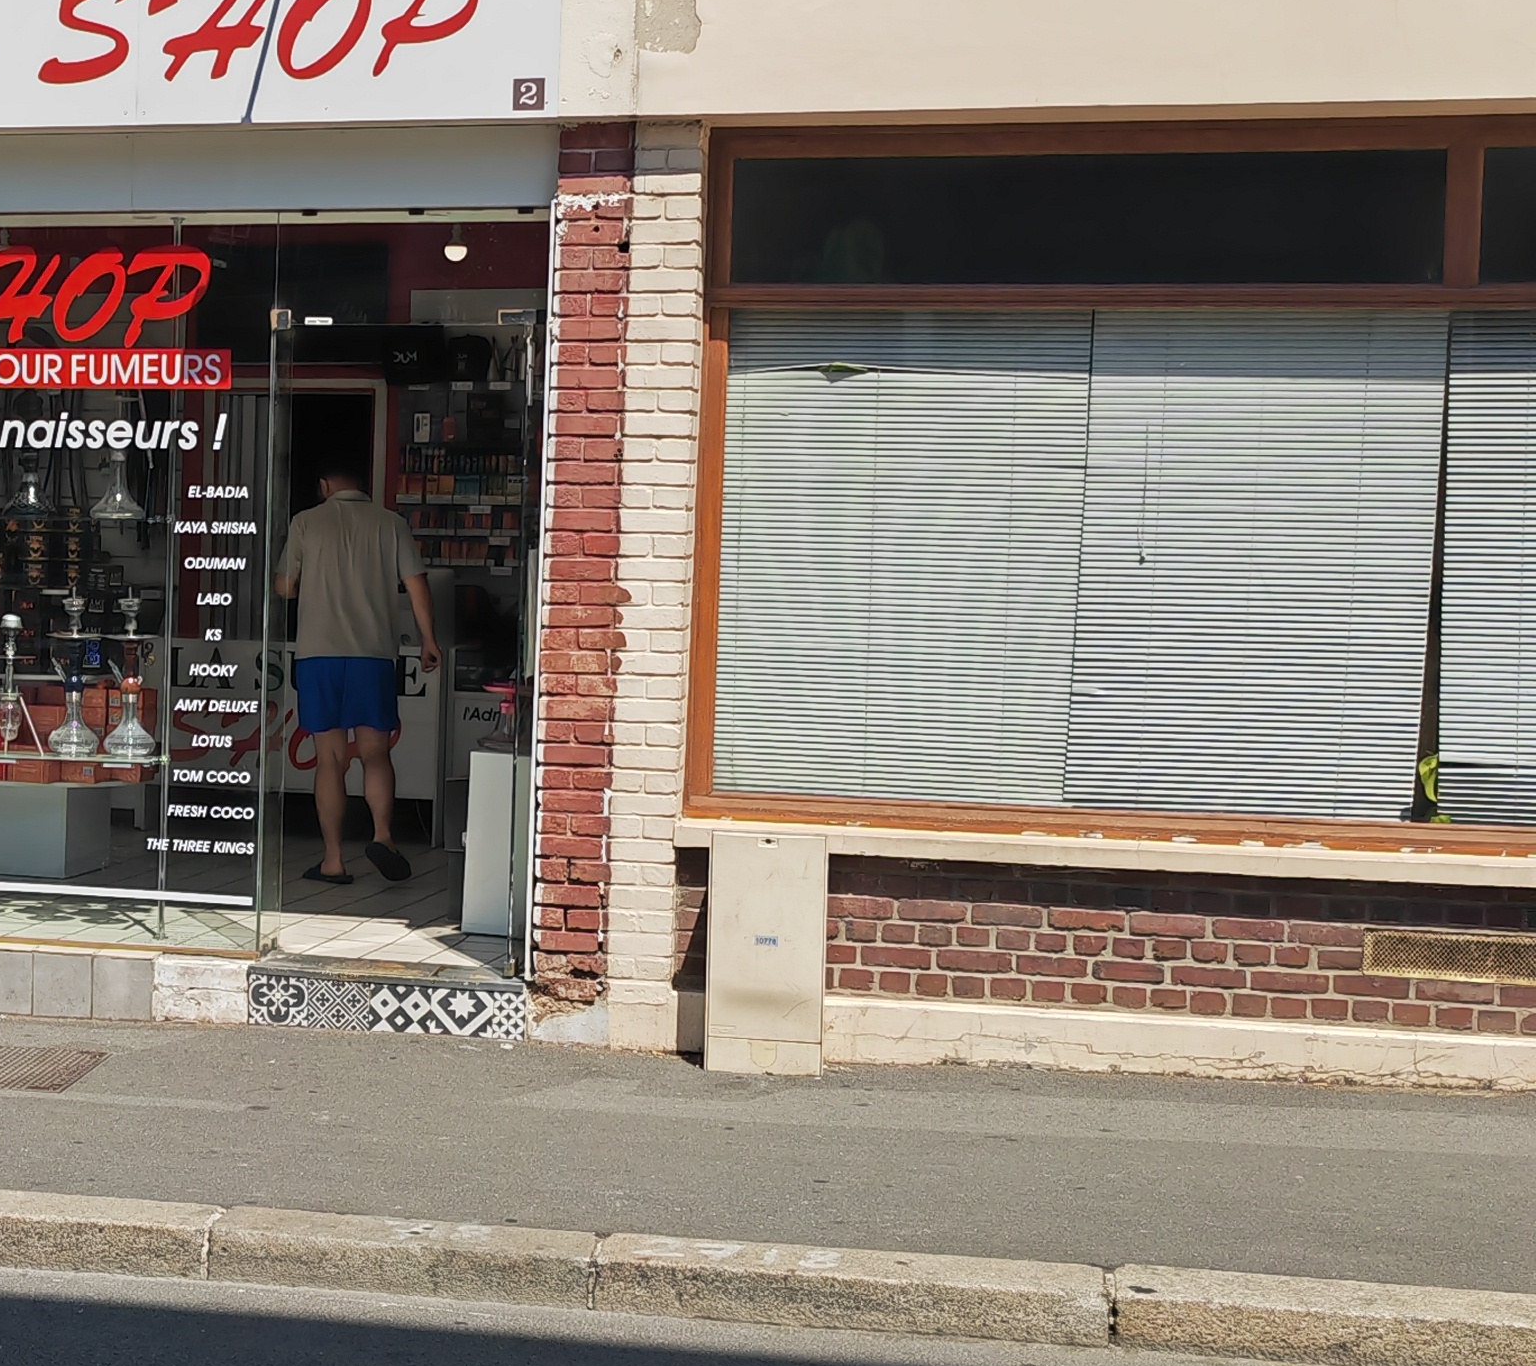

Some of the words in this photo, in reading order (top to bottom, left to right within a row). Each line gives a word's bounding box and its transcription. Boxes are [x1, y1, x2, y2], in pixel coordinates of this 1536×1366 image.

[518, 82, 539, 106] 2
[70, 353, 222, 386] FUMEURS
[187, 485, 249, 499] EL-BADIA
[173, 520, 208, 534] KAYA
[211, 521, 257, 535] SHISHA
[184, 557, 247, 570] ODUMAN
[196, 593, 232, 606] LABO
[205, 628, 222, 642] KS
[189, 663, 238, 677] HOOKY
[173, 698, 207, 712] AMY
[208, 700, 259, 713] DELUXE
[191, 735, 233, 748] LOTUS
[172, 769, 204, 783] TOM
[206, 770, 251, 784] COCO
[167, 804, 208, 818] FRESH
[210, 806, 255, 820] COCO
[146, 838, 170, 852] THE
[172, 839, 211, 853] THREE
[213, 841, 255, 855] KINGS
